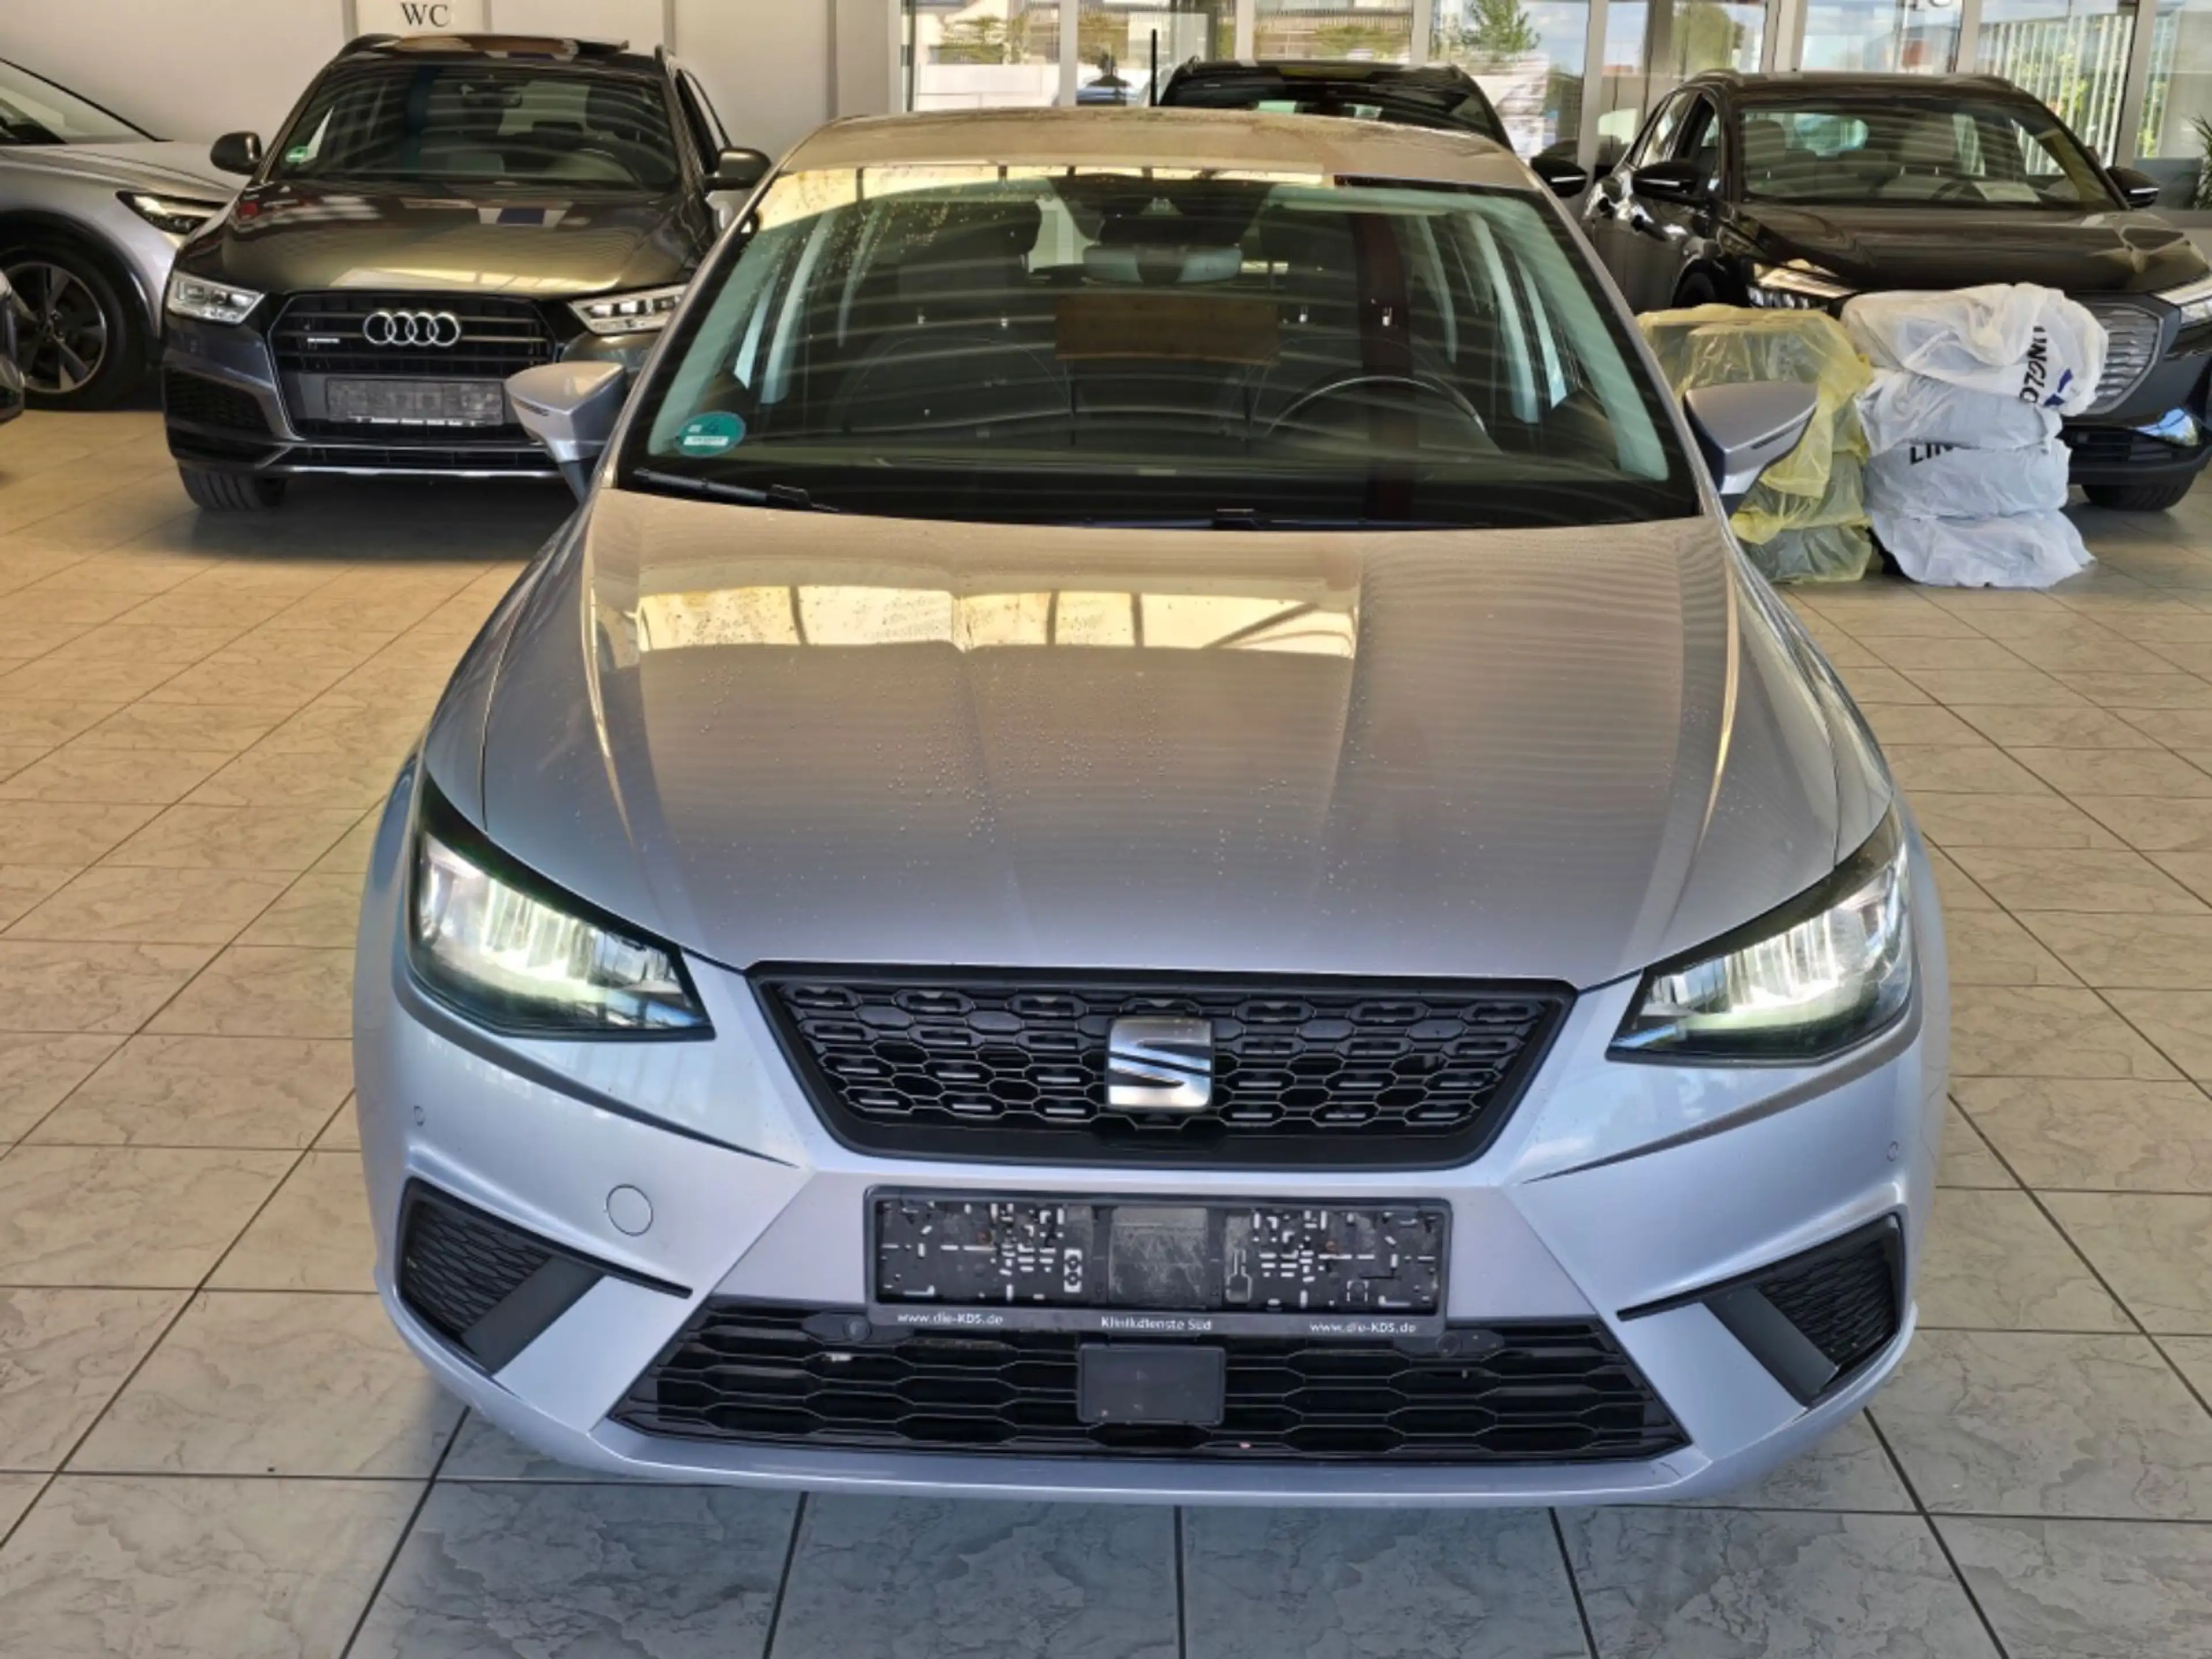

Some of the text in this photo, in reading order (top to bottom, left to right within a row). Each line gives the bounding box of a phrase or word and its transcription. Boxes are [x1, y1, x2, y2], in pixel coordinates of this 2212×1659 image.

[400, 2, 450, 27] WC
[897, 1311, 1003, 1325] www.die-KDS.de
[1101, 1316, 1184, 1330] Klinikdienste
[1309, 1321, 1417, 1334] www.die-KDS.de
